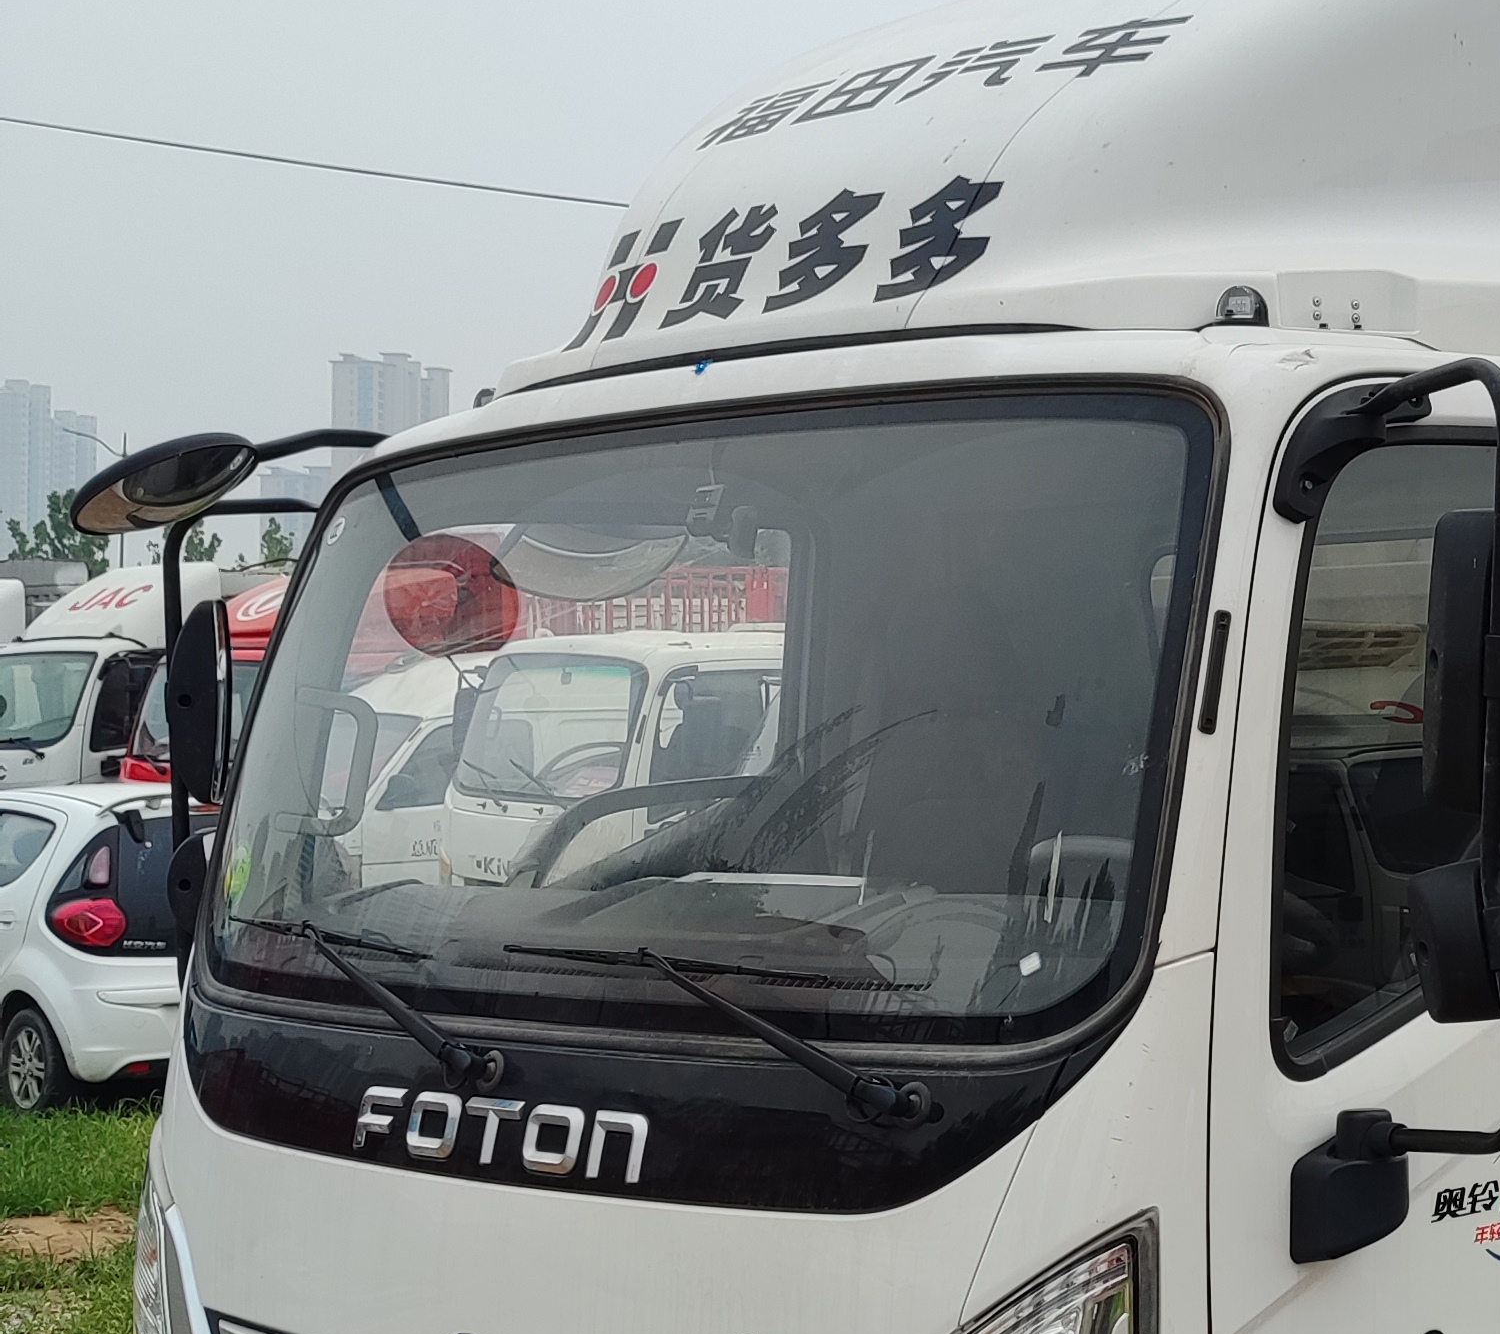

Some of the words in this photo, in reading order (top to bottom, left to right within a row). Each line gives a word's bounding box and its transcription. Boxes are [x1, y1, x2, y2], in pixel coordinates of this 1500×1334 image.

[696, 14, 1194, 151] 福田汽车
[656, 175, 1005, 330] 货多多
[69, 583, 153, 612] JAC
[352, 1084, 650, 1185] FOTON
